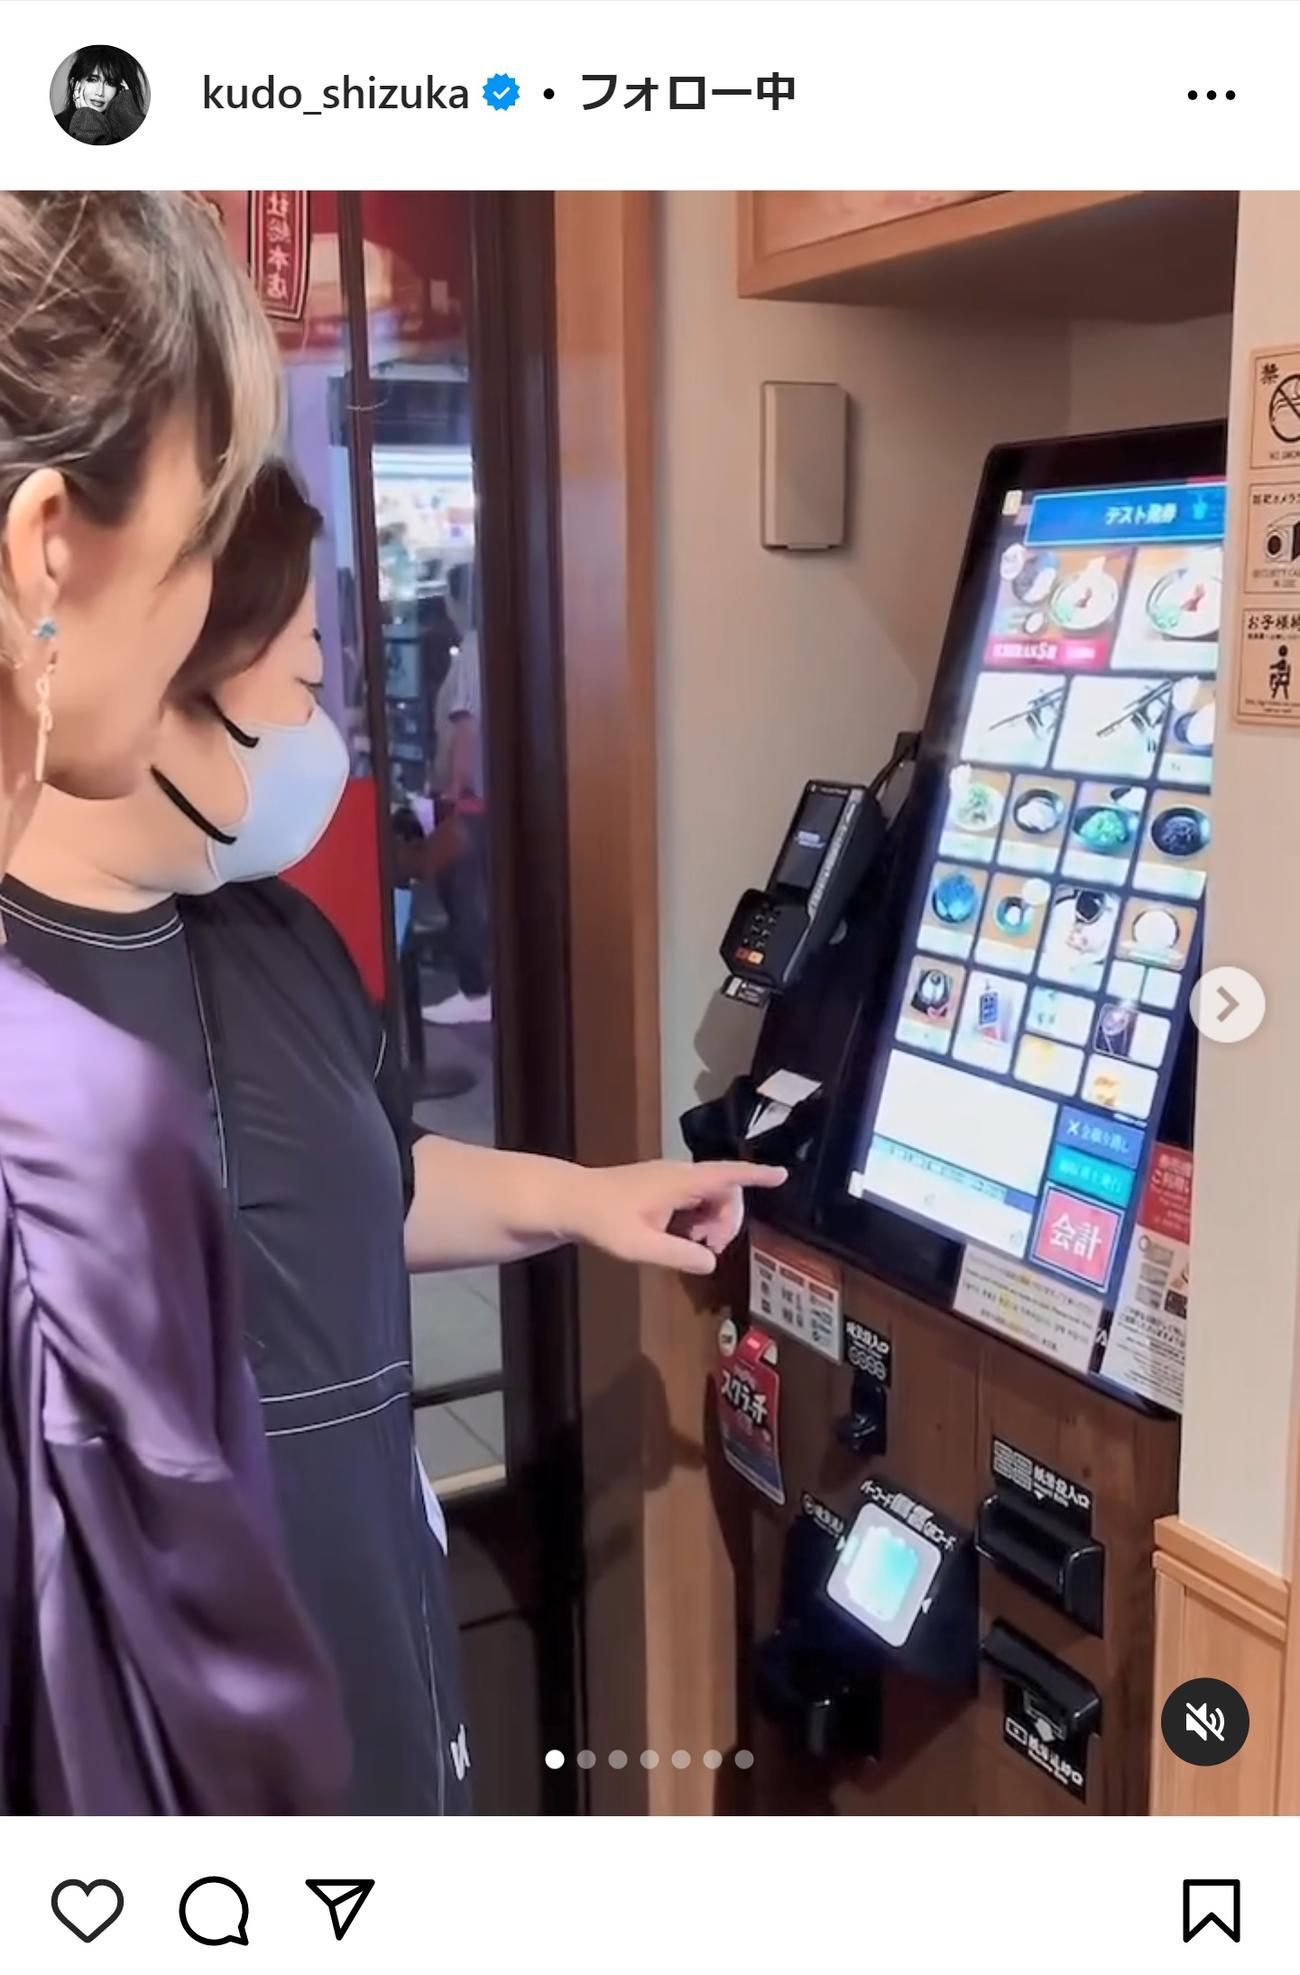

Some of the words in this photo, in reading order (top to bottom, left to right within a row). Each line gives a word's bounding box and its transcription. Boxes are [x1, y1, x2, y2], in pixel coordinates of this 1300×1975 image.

[1049, 1213, 1103, 1261] 会計
[721, 1369, 768, 1424] スクラッチ
